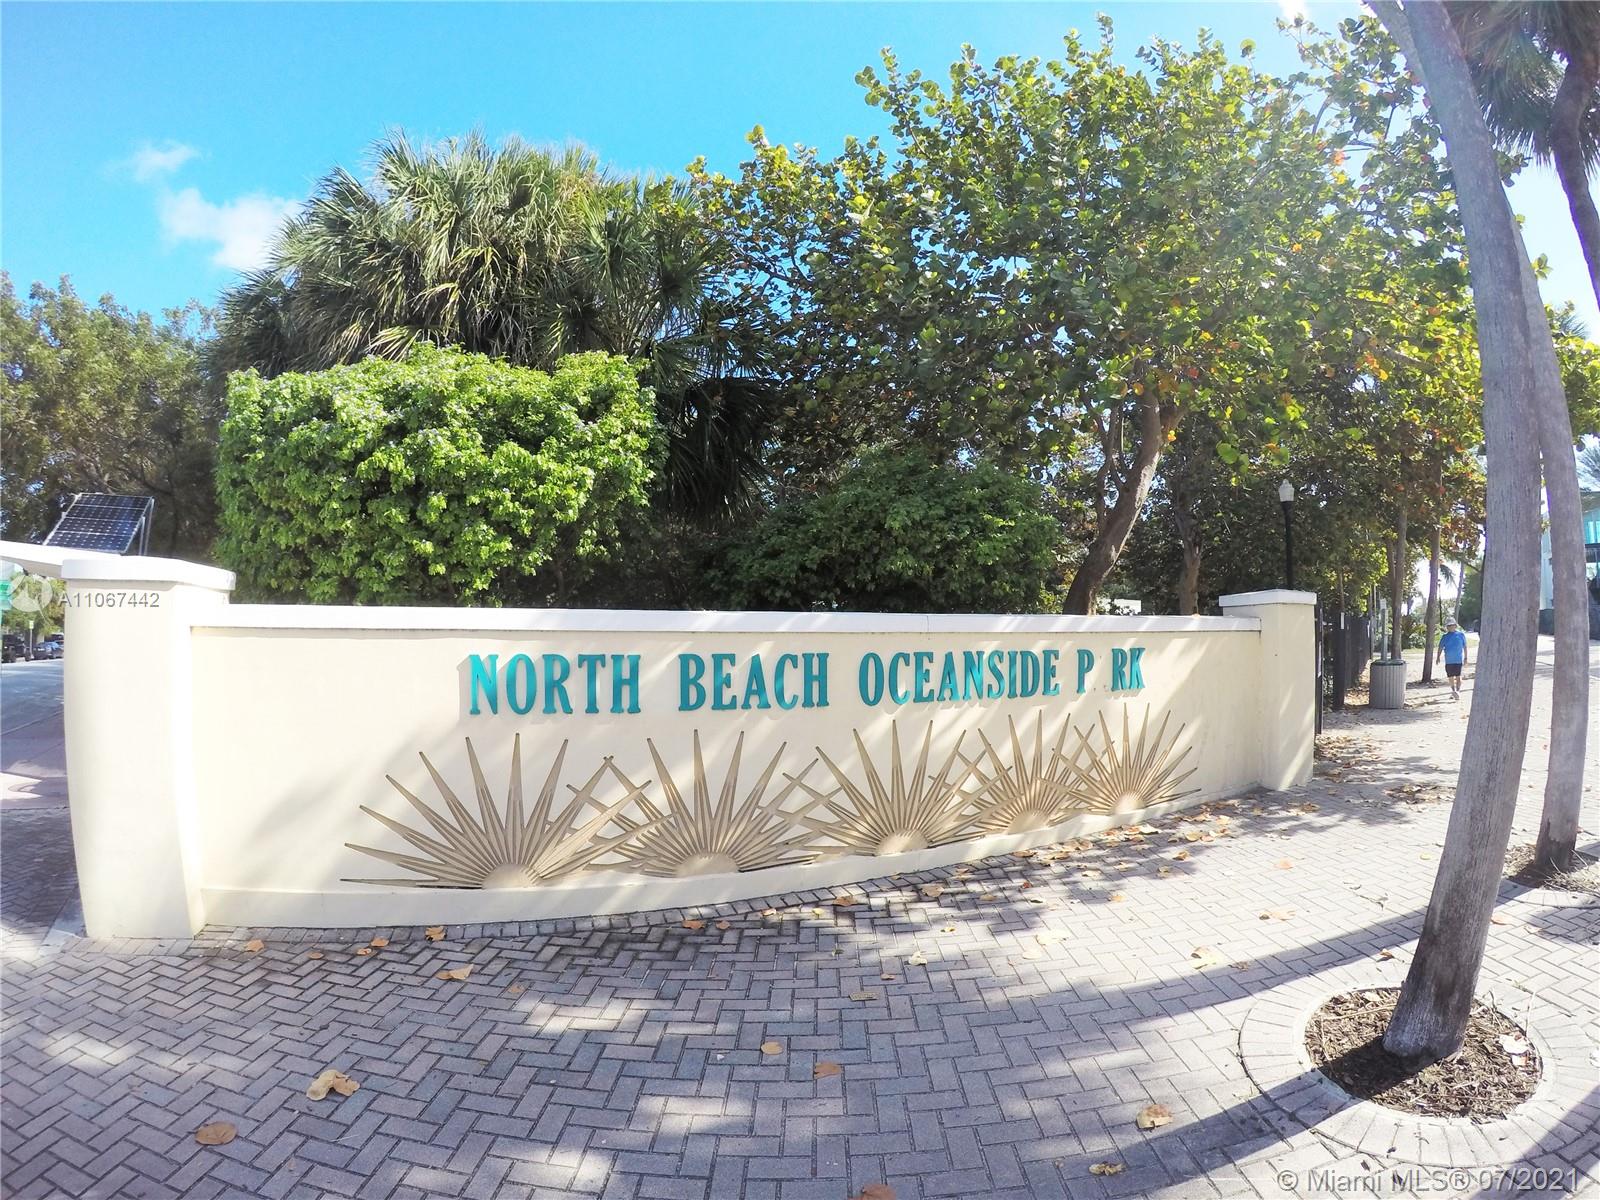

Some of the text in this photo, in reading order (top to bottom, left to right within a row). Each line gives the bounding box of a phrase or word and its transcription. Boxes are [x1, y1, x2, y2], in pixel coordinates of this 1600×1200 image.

[468, 647, 1146, 715] NORTH BEACH OCEANSIDE PRK
